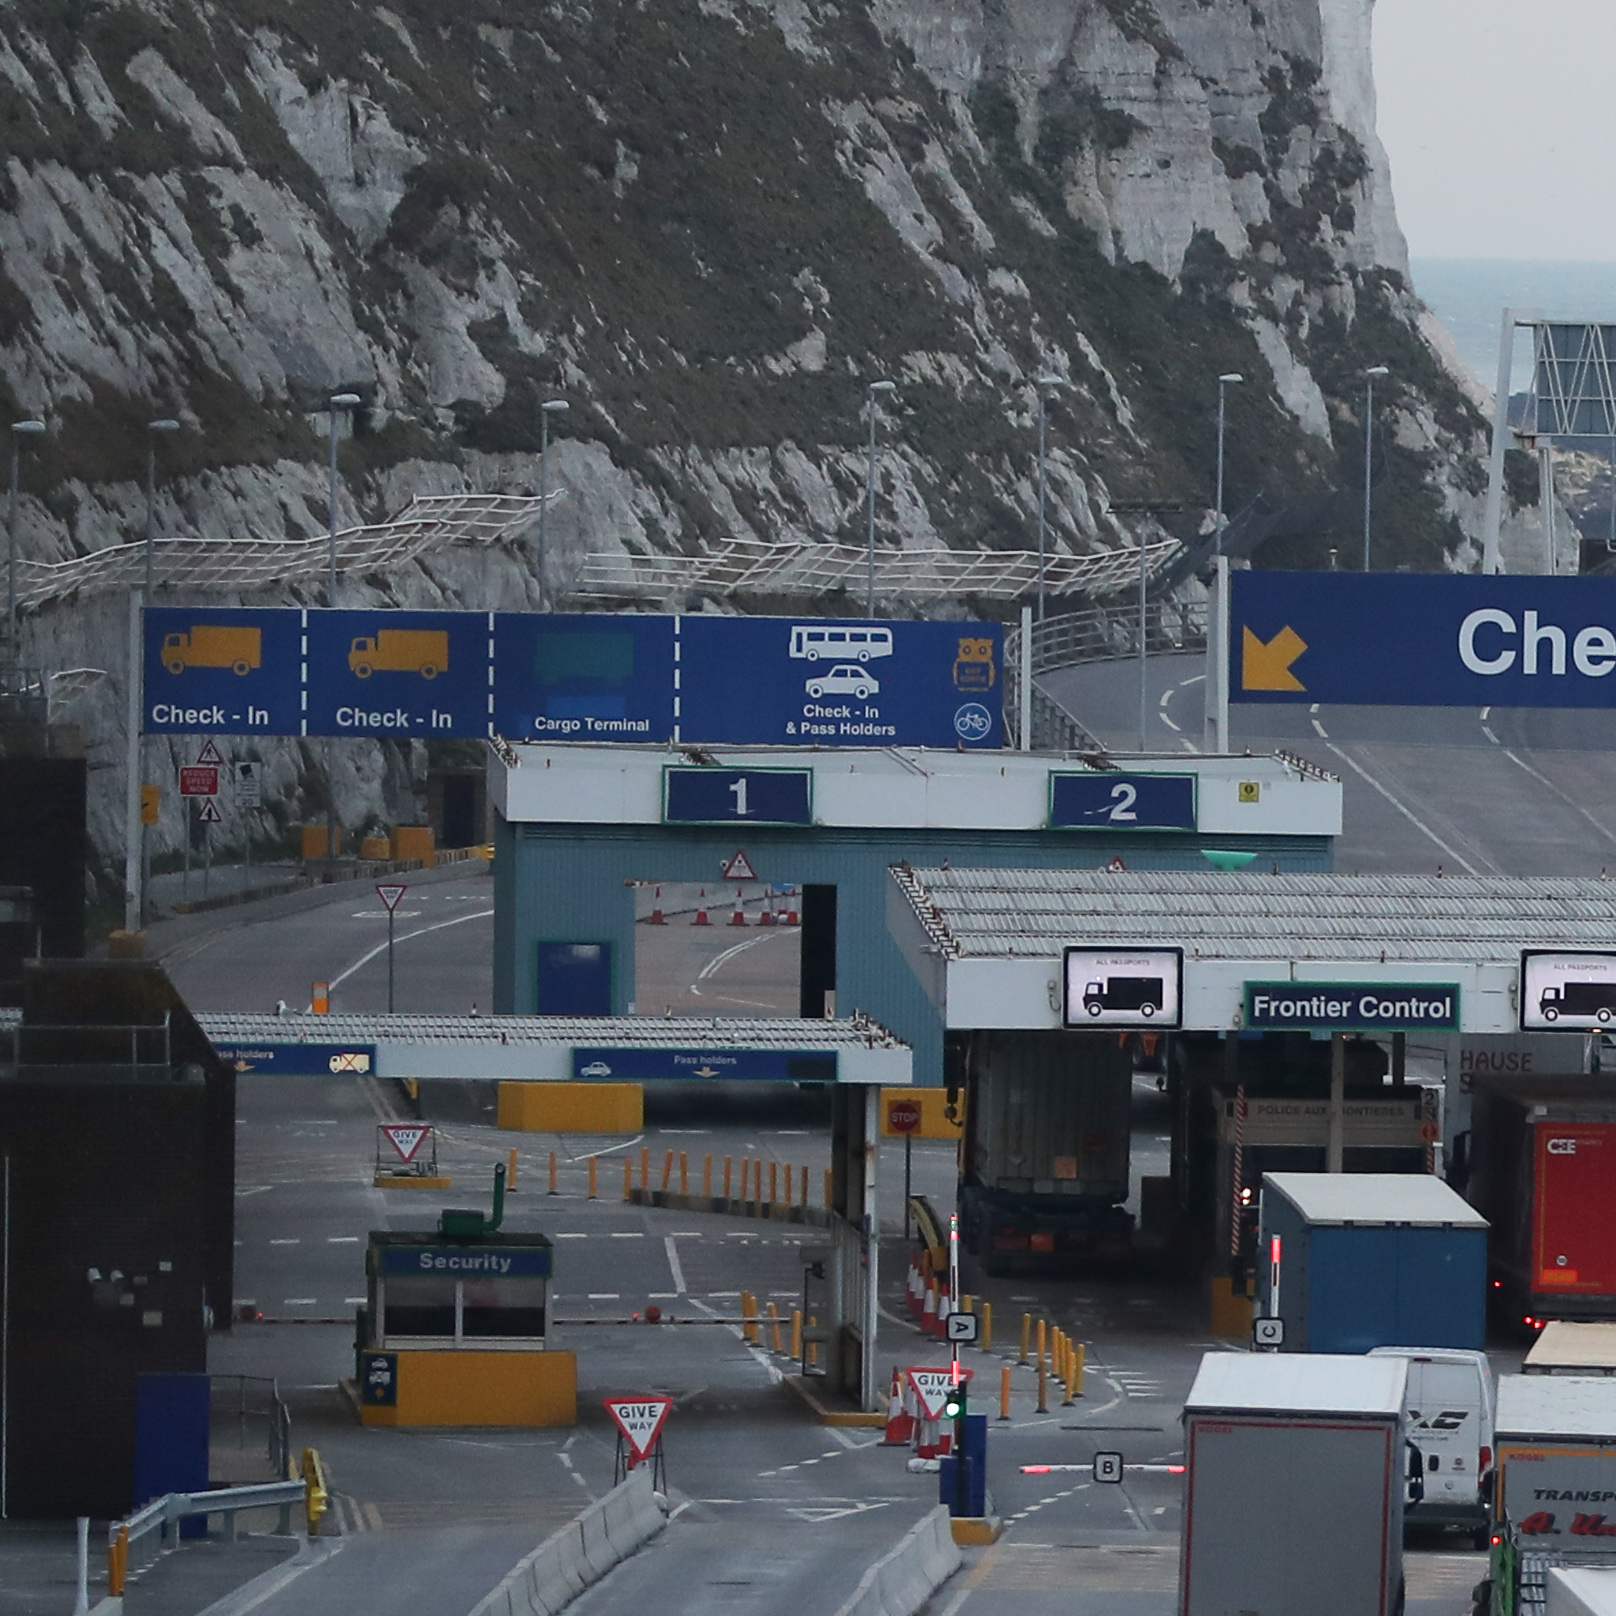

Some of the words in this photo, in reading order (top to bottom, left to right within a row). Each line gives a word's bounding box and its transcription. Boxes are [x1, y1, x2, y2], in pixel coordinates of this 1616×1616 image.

[152, 704, 225, 725] Check
[247, 705, 269, 725] In
[336, 707, 409, 728] Check
[432, 709, 452, 729] In
[803, 704, 851, 719] Check
[864, 705, 879, 718] In
[534, 716, 580, 733] Cargo
[584, 717, 650, 732] Terminal
[786, 721, 796, 735] &
[801, 722, 836, 735] Pass
[839, 721, 896, 736] Holders
[729, 778, 747, 815] 1
[1109, 782, 1138, 821] 2
[1253, 996, 1351, 1017] Frontier
[1358, 997, 1451, 1019] Control
[1460, 1049, 1533, 1072] HAUSE
[420, 1252, 511, 1273] Security
[954, 1320, 969, 1333] A
[925, 1388, 947, 1397] WA
[619, 1405, 658, 1419] GIVE
[629, 1421, 653, 1431] WAY
[1103, 1460, 1114, 1474] B
